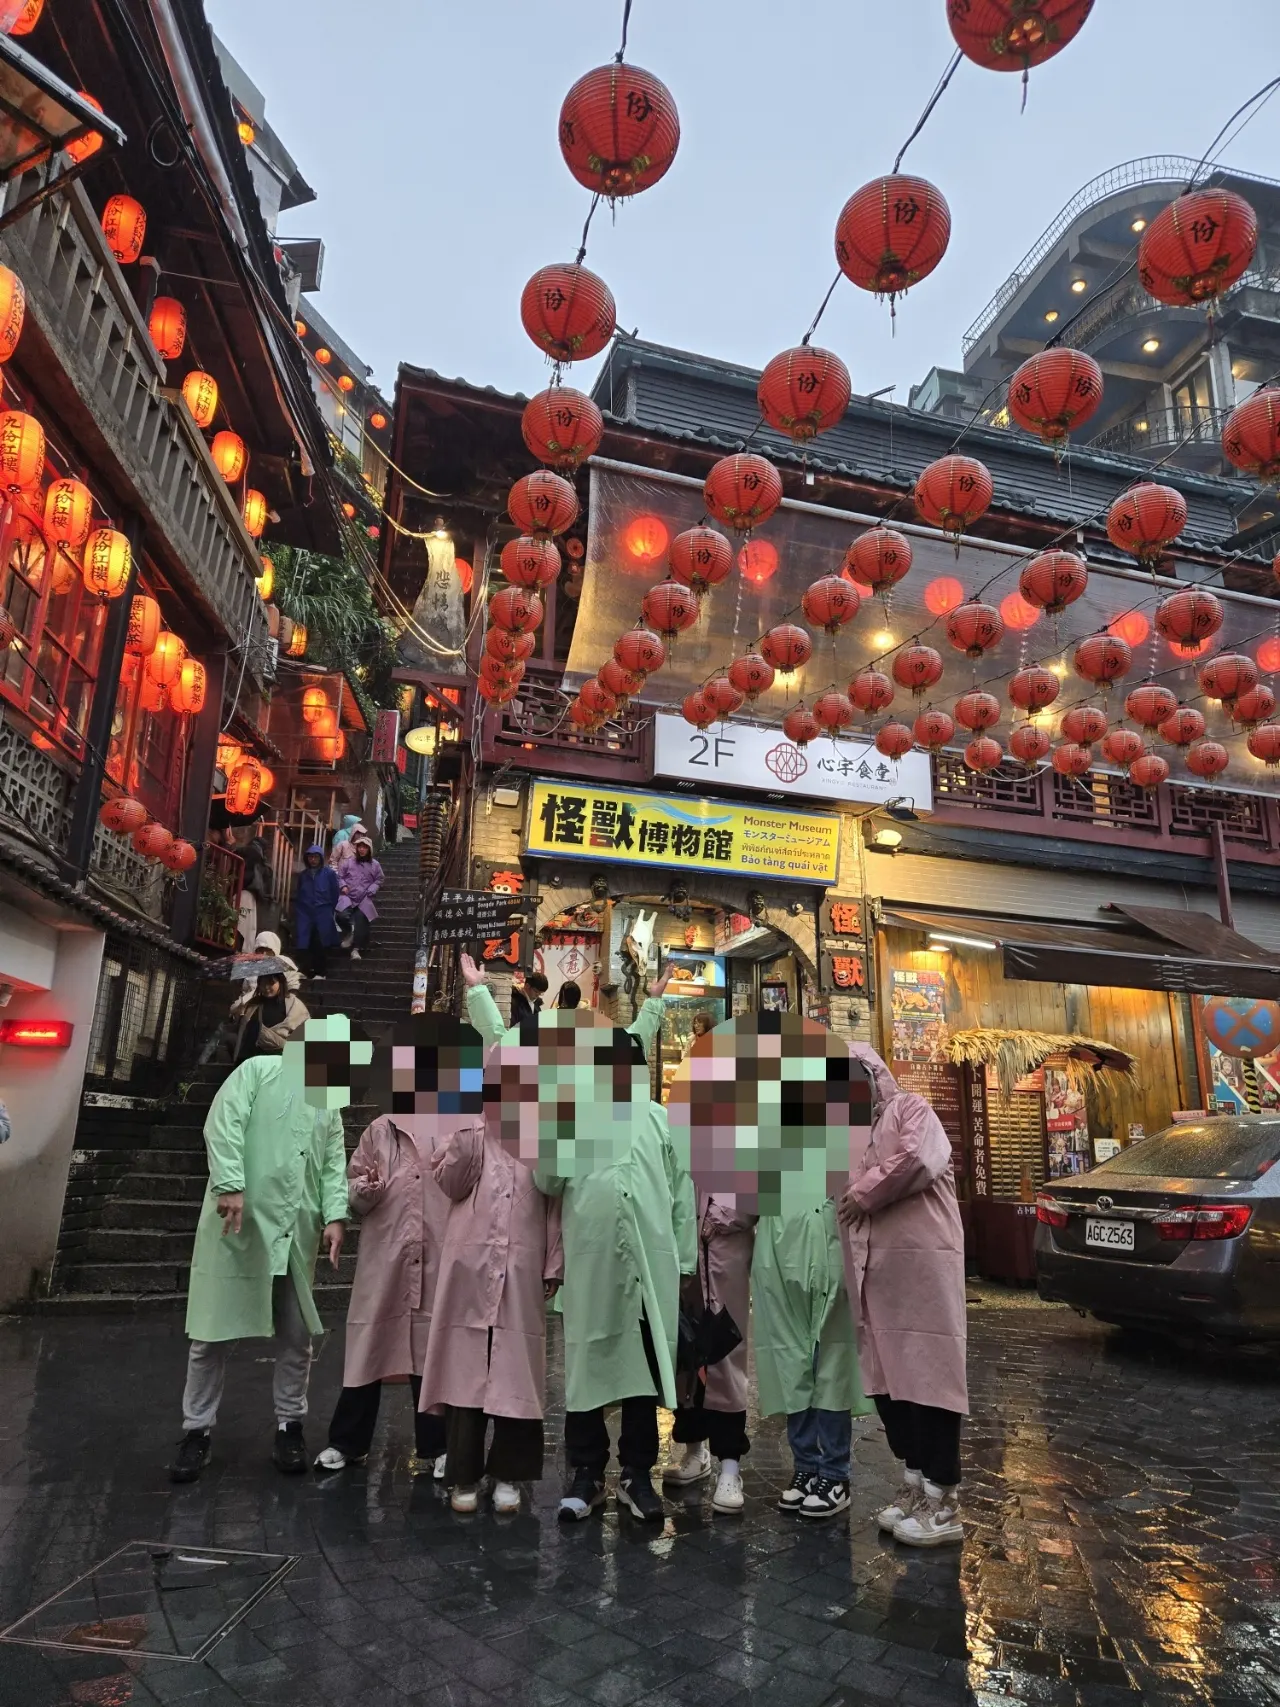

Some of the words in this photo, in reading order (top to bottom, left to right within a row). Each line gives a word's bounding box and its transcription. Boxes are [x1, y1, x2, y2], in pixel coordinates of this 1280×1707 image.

[625, 90, 653, 122] 份
[893, 196, 920, 224] 份
[1190, 215, 1220, 243] 份
[544, 287, 566, 312] 份
[797, 372, 821, 393] 份
[1074, 375, 1096, 397] 份
[1015, 383, 1032, 406] 份
[555, 407, 575, 427] 份
[743, 472, 761, 491] 份
[959, 476, 976, 492] 份
[535, 494, 552, 511] 份
[1117, 514, 1133, 531] 份
[523, 557, 536, 571] 份
[697, 548, 712, 564] 份
[884, 550, 897, 565] 份
[1059, 573, 1074, 587] 份
[688, 735, 736, 768] 2F
[540, 793, 734, 862] 怪獸博物館
[743, 815, 786, 829] Monster
[789, 820, 832, 835] Museum
[743, 829, 831, 847] モンスターミュージアム
[741, 854, 760, 864] Bảo
[763, 856, 785, 869] tàng
[788, 860, 810, 871] quái
[812, 863, 828, 874] vật
[973, 1117, 987, 1196] 苦命者免費
